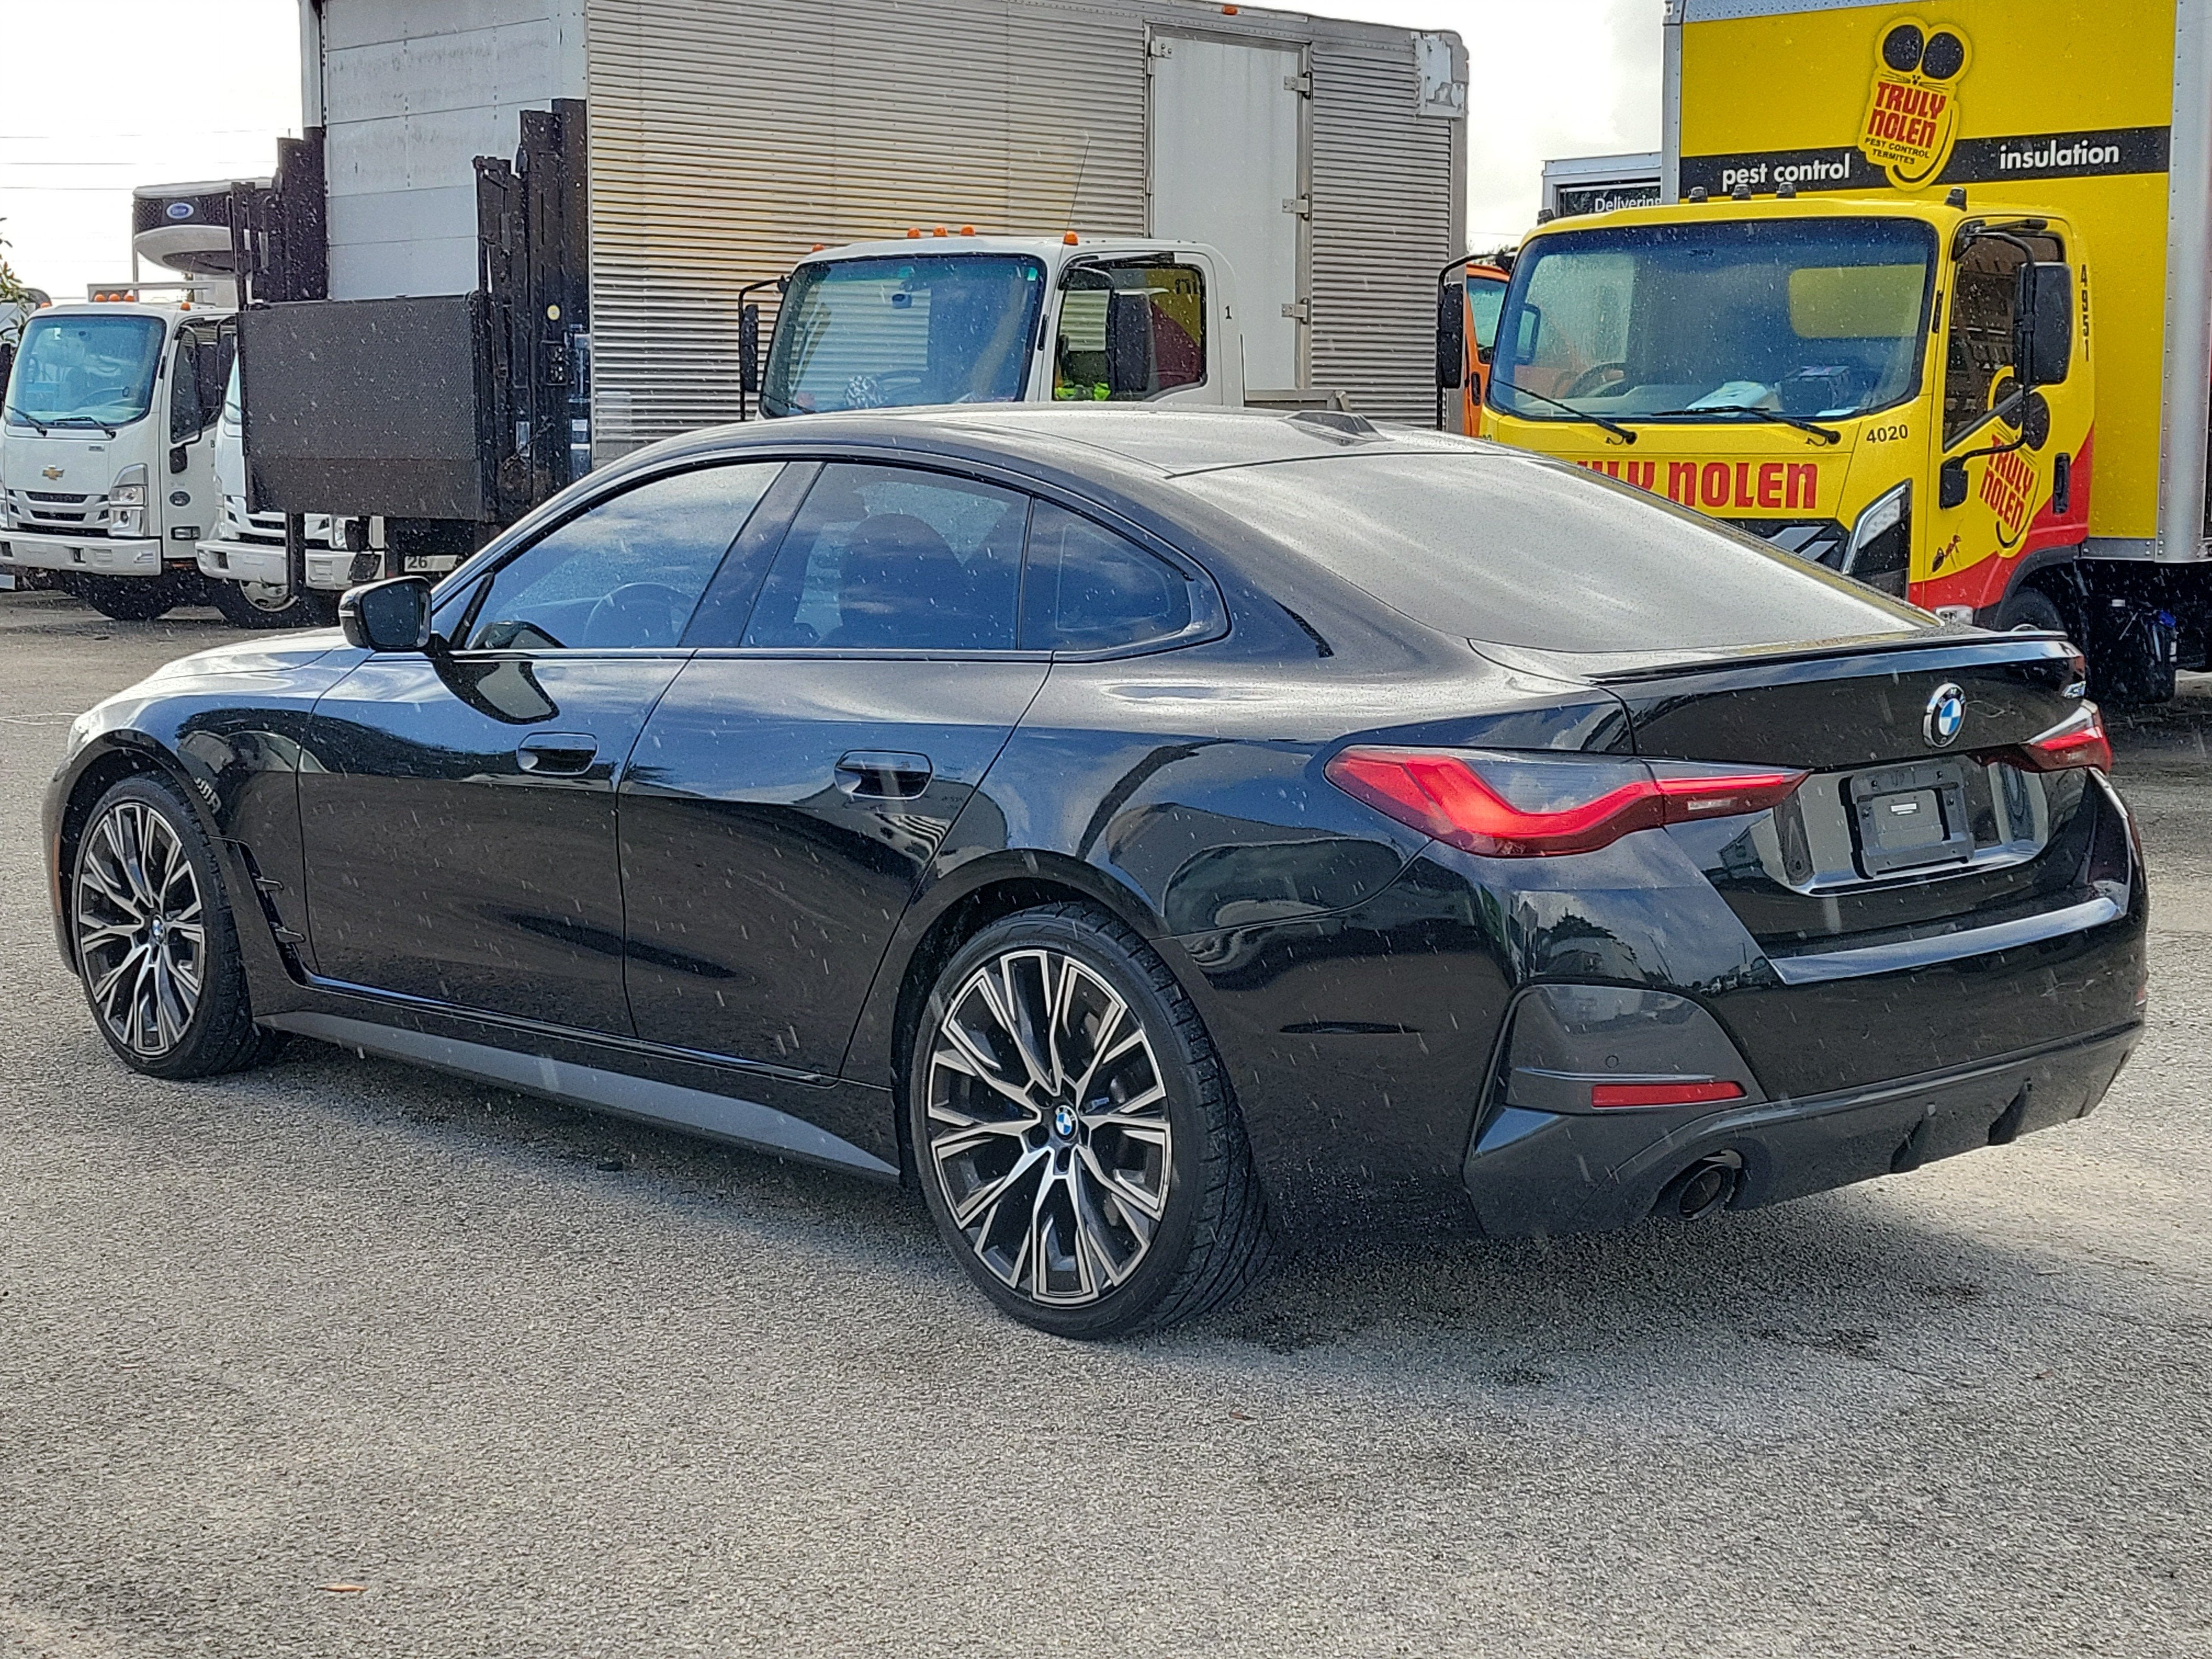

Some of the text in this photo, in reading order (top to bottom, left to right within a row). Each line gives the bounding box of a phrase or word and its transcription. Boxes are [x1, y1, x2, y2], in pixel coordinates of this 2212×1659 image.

[1875, 81, 1946, 120] TRULY
[1867, 108, 1937, 149] NOLEN
[1865, 137, 1930, 159] PEST CONTROL
[1872, 148, 1915, 165] TERMITES
[2000, 139, 2119, 170] insulation
[1722, 153, 1850, 192] pest control
[1225, 305, 1233, 320] 1
[1866, 424, 1908, 443] 4020
[1668, 462, 1818, 509] NOLEN
